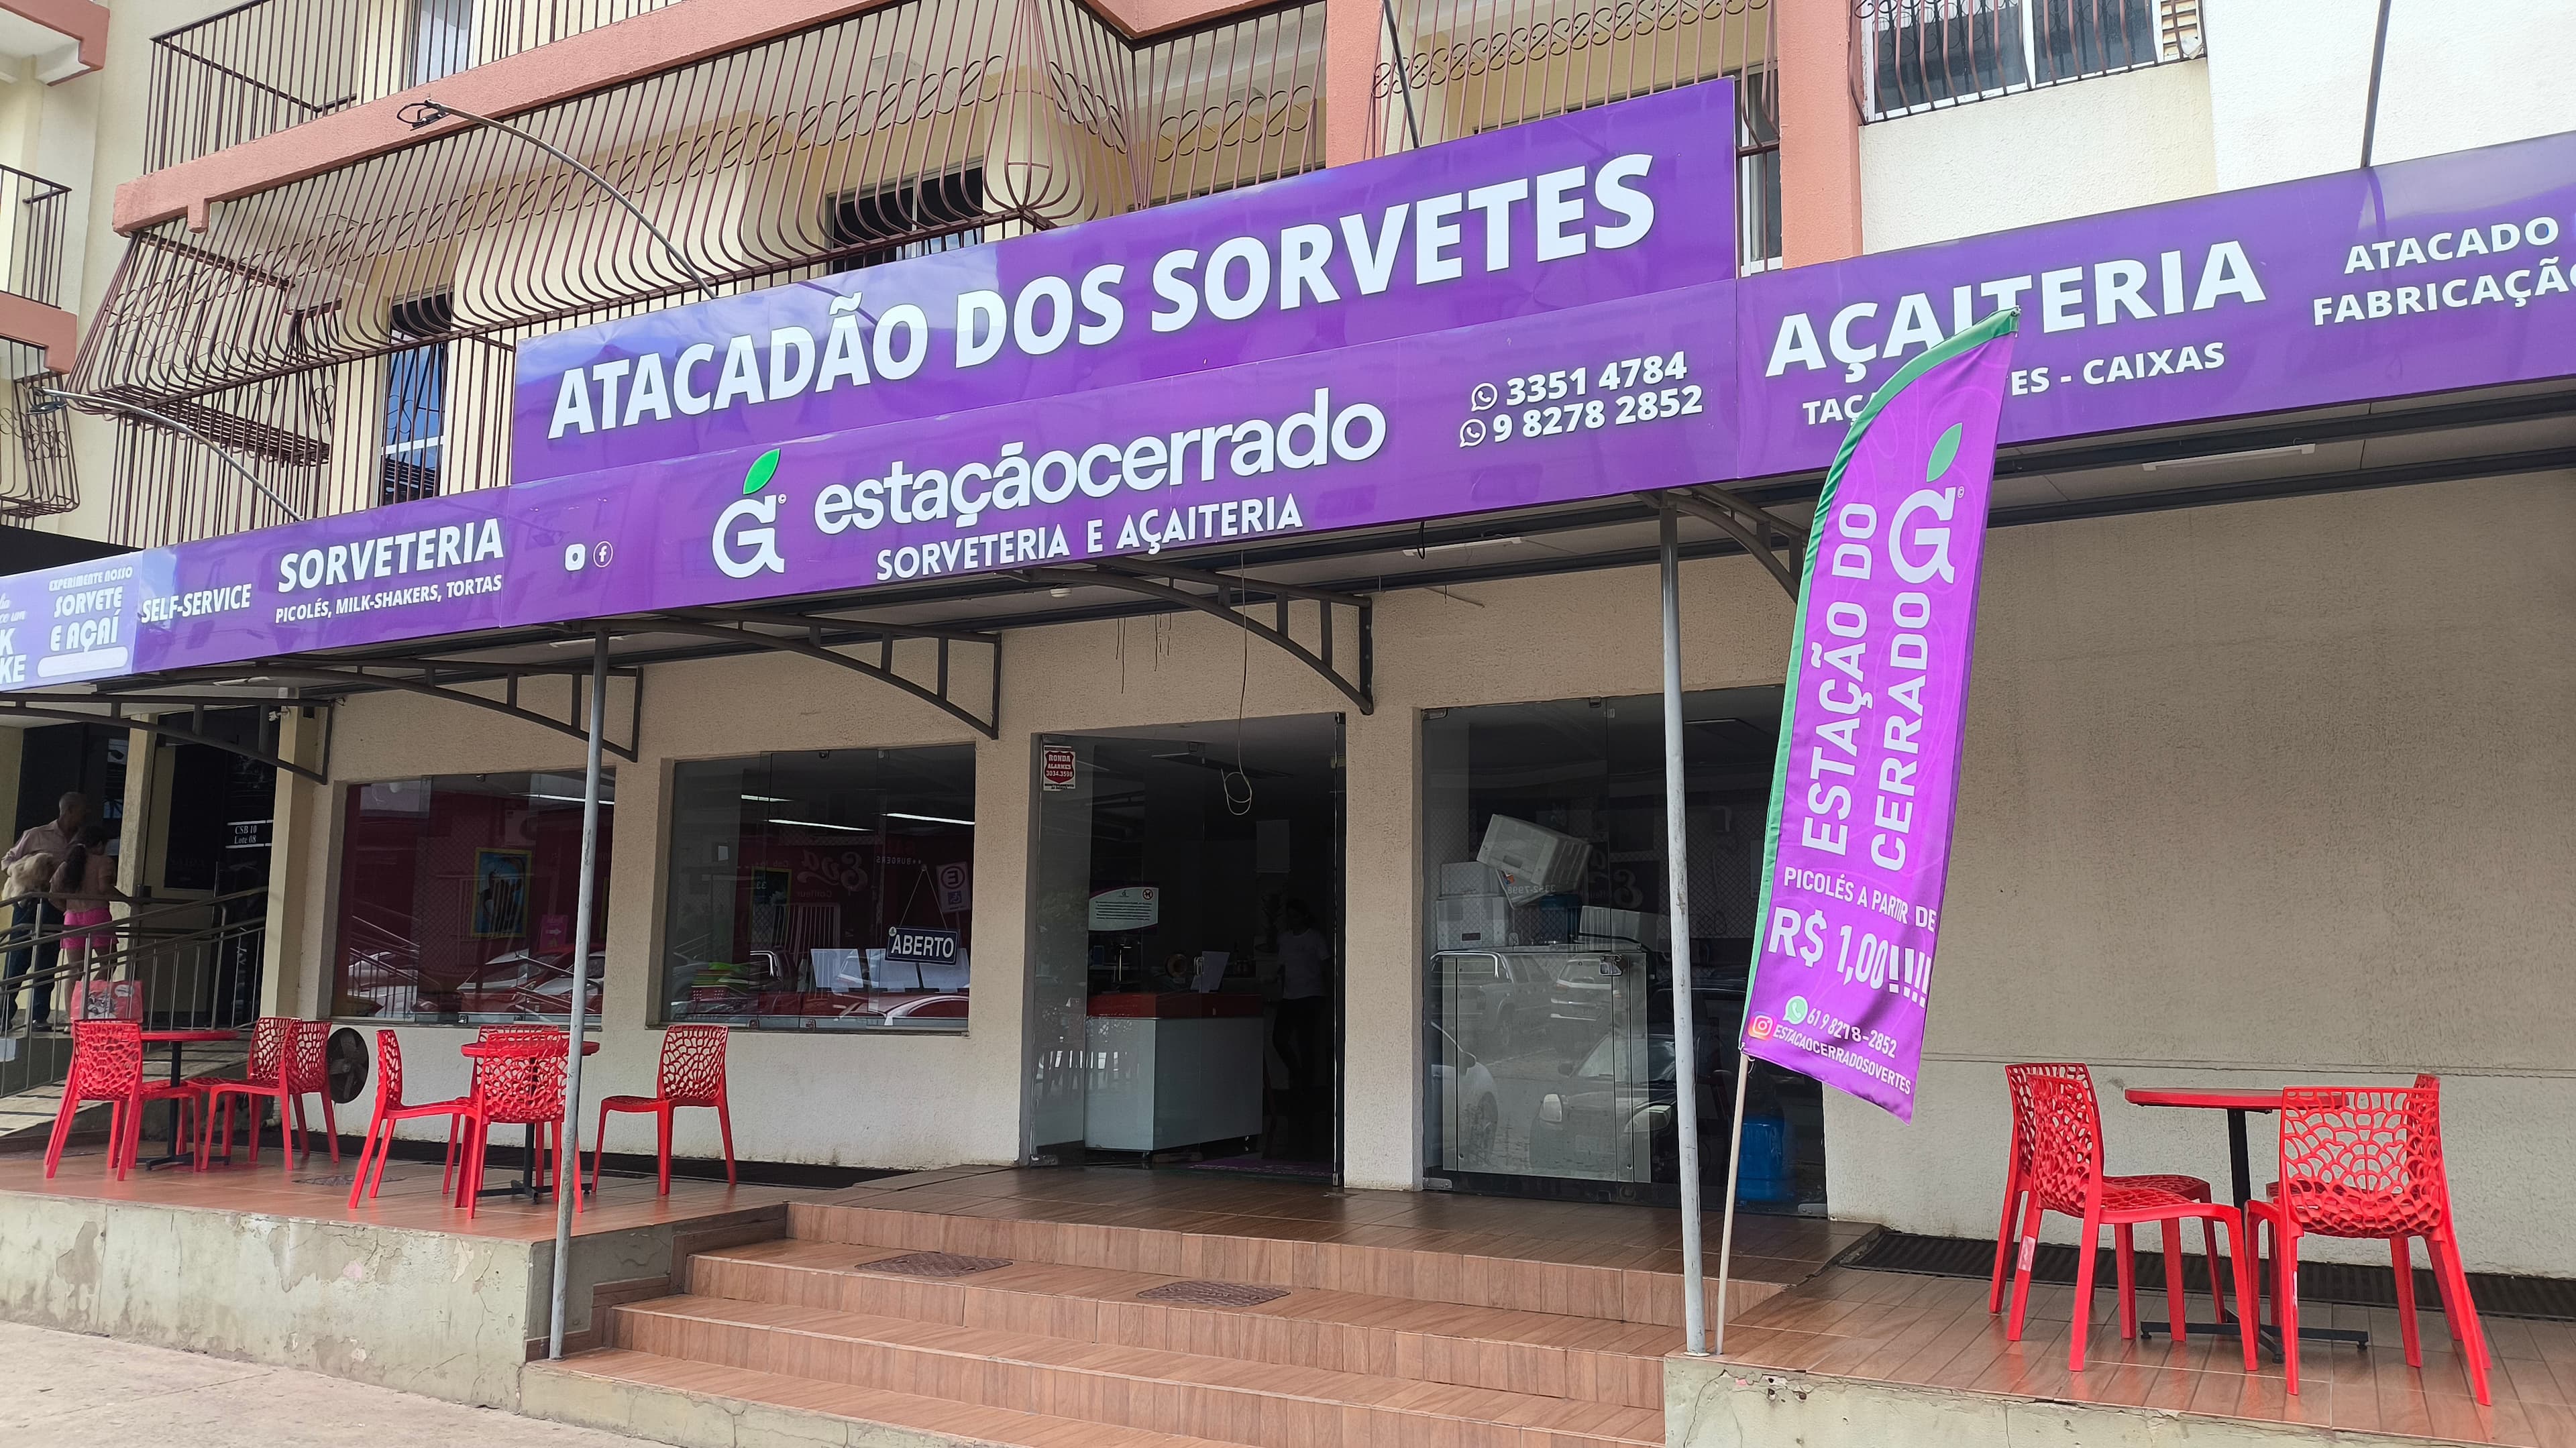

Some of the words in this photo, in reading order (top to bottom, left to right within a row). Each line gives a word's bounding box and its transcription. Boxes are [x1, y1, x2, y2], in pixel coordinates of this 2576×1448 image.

[2344, 217, 2559, 274] ATACADO
[547, 292, 928, 440] ATACADÃO
[955, 263, 1125, 368] DOS
[1151, 154, 1656, 333] SORVETES
[1765, 240, 2266, 383] AÇAITERIA
[1506, 368, 1587, 406] 3351
[1599, 351, 1688, 391] 4784
[2083, 342, 2225, 384] CAIXAS
[1493, 414, 1513, 442] 9
[1522, 400, 1605, 438] 8278
[1615, 385, 1703, 425] 2852
[278, 518, 504, 593] SORVETERIA
[876, 523, 1070, 581] SORVETERIA
[1087, 519, 1104, 553] E
[1116, 492, 1303, 555] AÇAITERIA
[1831, 503, 1878, 580] DO
[48, 572, 103, 592] EXPERIMENTE
[105, 566, 133, 582] NOSSO
[54, 586, 123, 618] SORVETE
[141, 583, 252, 623] SELF-SERVICE
[275, 596, 333, 624] PICOLÉS,
[335, 583, 443, 616] MILK-SHAKERS,
[446, 574, 502, 598] TORTAS
[50, 625, 62, 652] E
[66, 608, 122, 652] AÇAÍ
[1801, 601, 1874, 856] ESTAÇÃO
[1870, 592, 1931, 872] CERRADO
[1049, 755, 1071, 763] RONDA
[1784, 867, 1854, 903] PICOLÉS
[1857, 886, 1868, 907] A
[1871, 889, 1909, 925] PARTIR
[1915, 905, 1937, 933] DE
[890, 935, 954, 958] ABERTO
[1768, 907, 1828, 968] R$
[1773, 1024, 1912, 1095] ESTACAOCERRADOSOVERTES
[1807, 1007, 1821, 1027] 61
[1819, 1013, 1830, 1030] 9
[1827, 1018, 1898, 1059] 8278-2852
